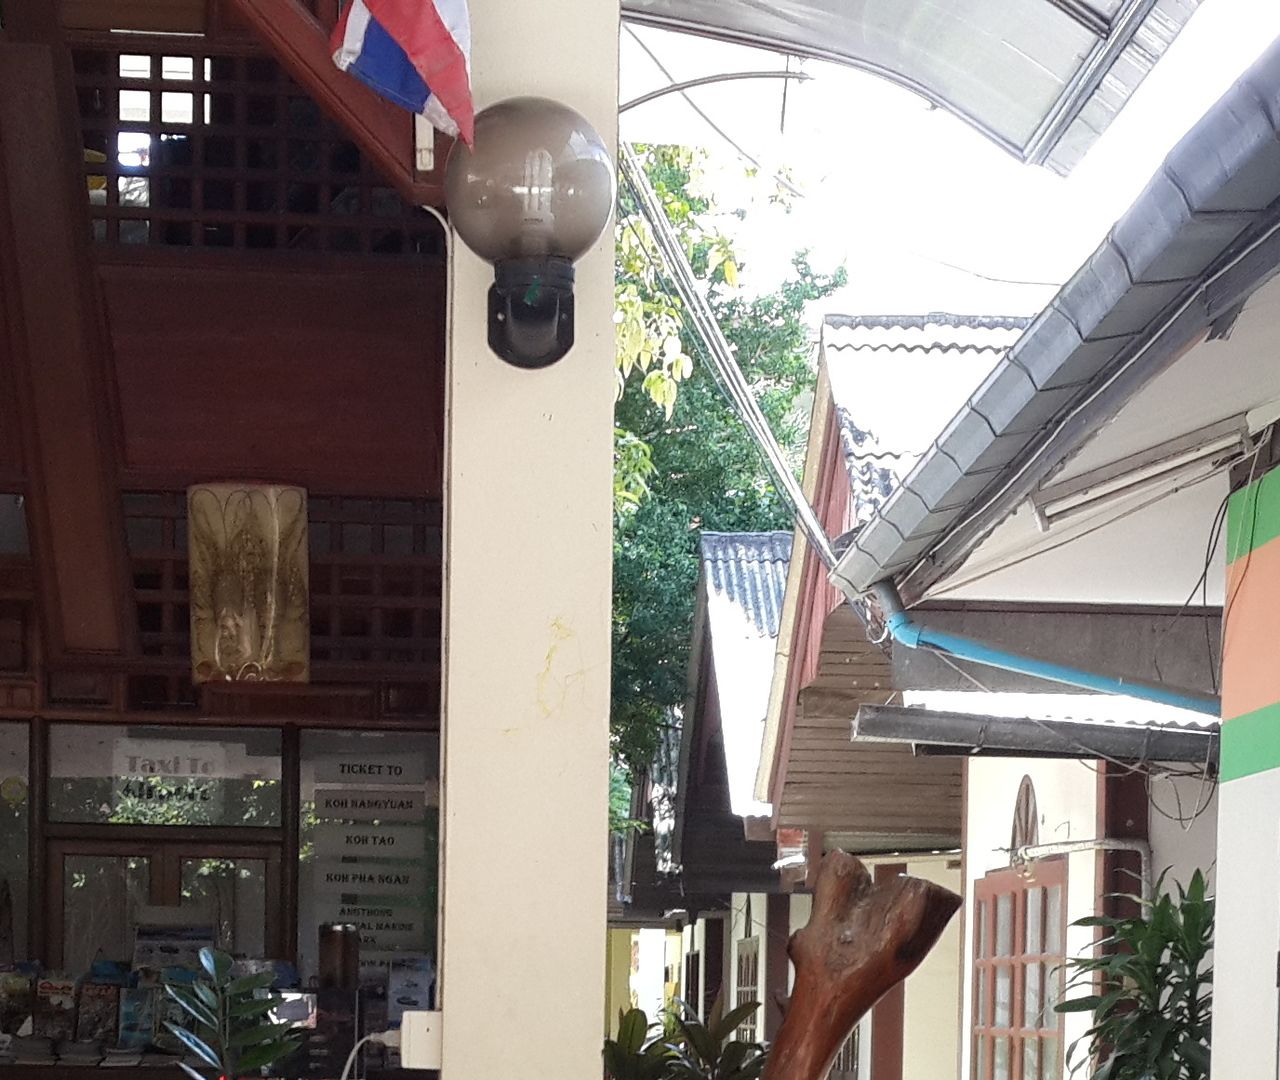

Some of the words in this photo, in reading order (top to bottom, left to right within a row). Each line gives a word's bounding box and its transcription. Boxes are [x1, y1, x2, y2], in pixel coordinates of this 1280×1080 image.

[125, 755, 181, 774] Taxi
[186, 757, 215, 774] To
[339, 763, 383, 775] TICKET
[387, 765, 403, 776] TO
[325, 799, 348, 809] KOH
[346, 835, 368, 845] KOH
[372, 835, 395, 846] TAO
[325, 873, 348, 882] KOH
[351, 873, 374, 883] PHA
[378, 874, 410, 885] NGAN
